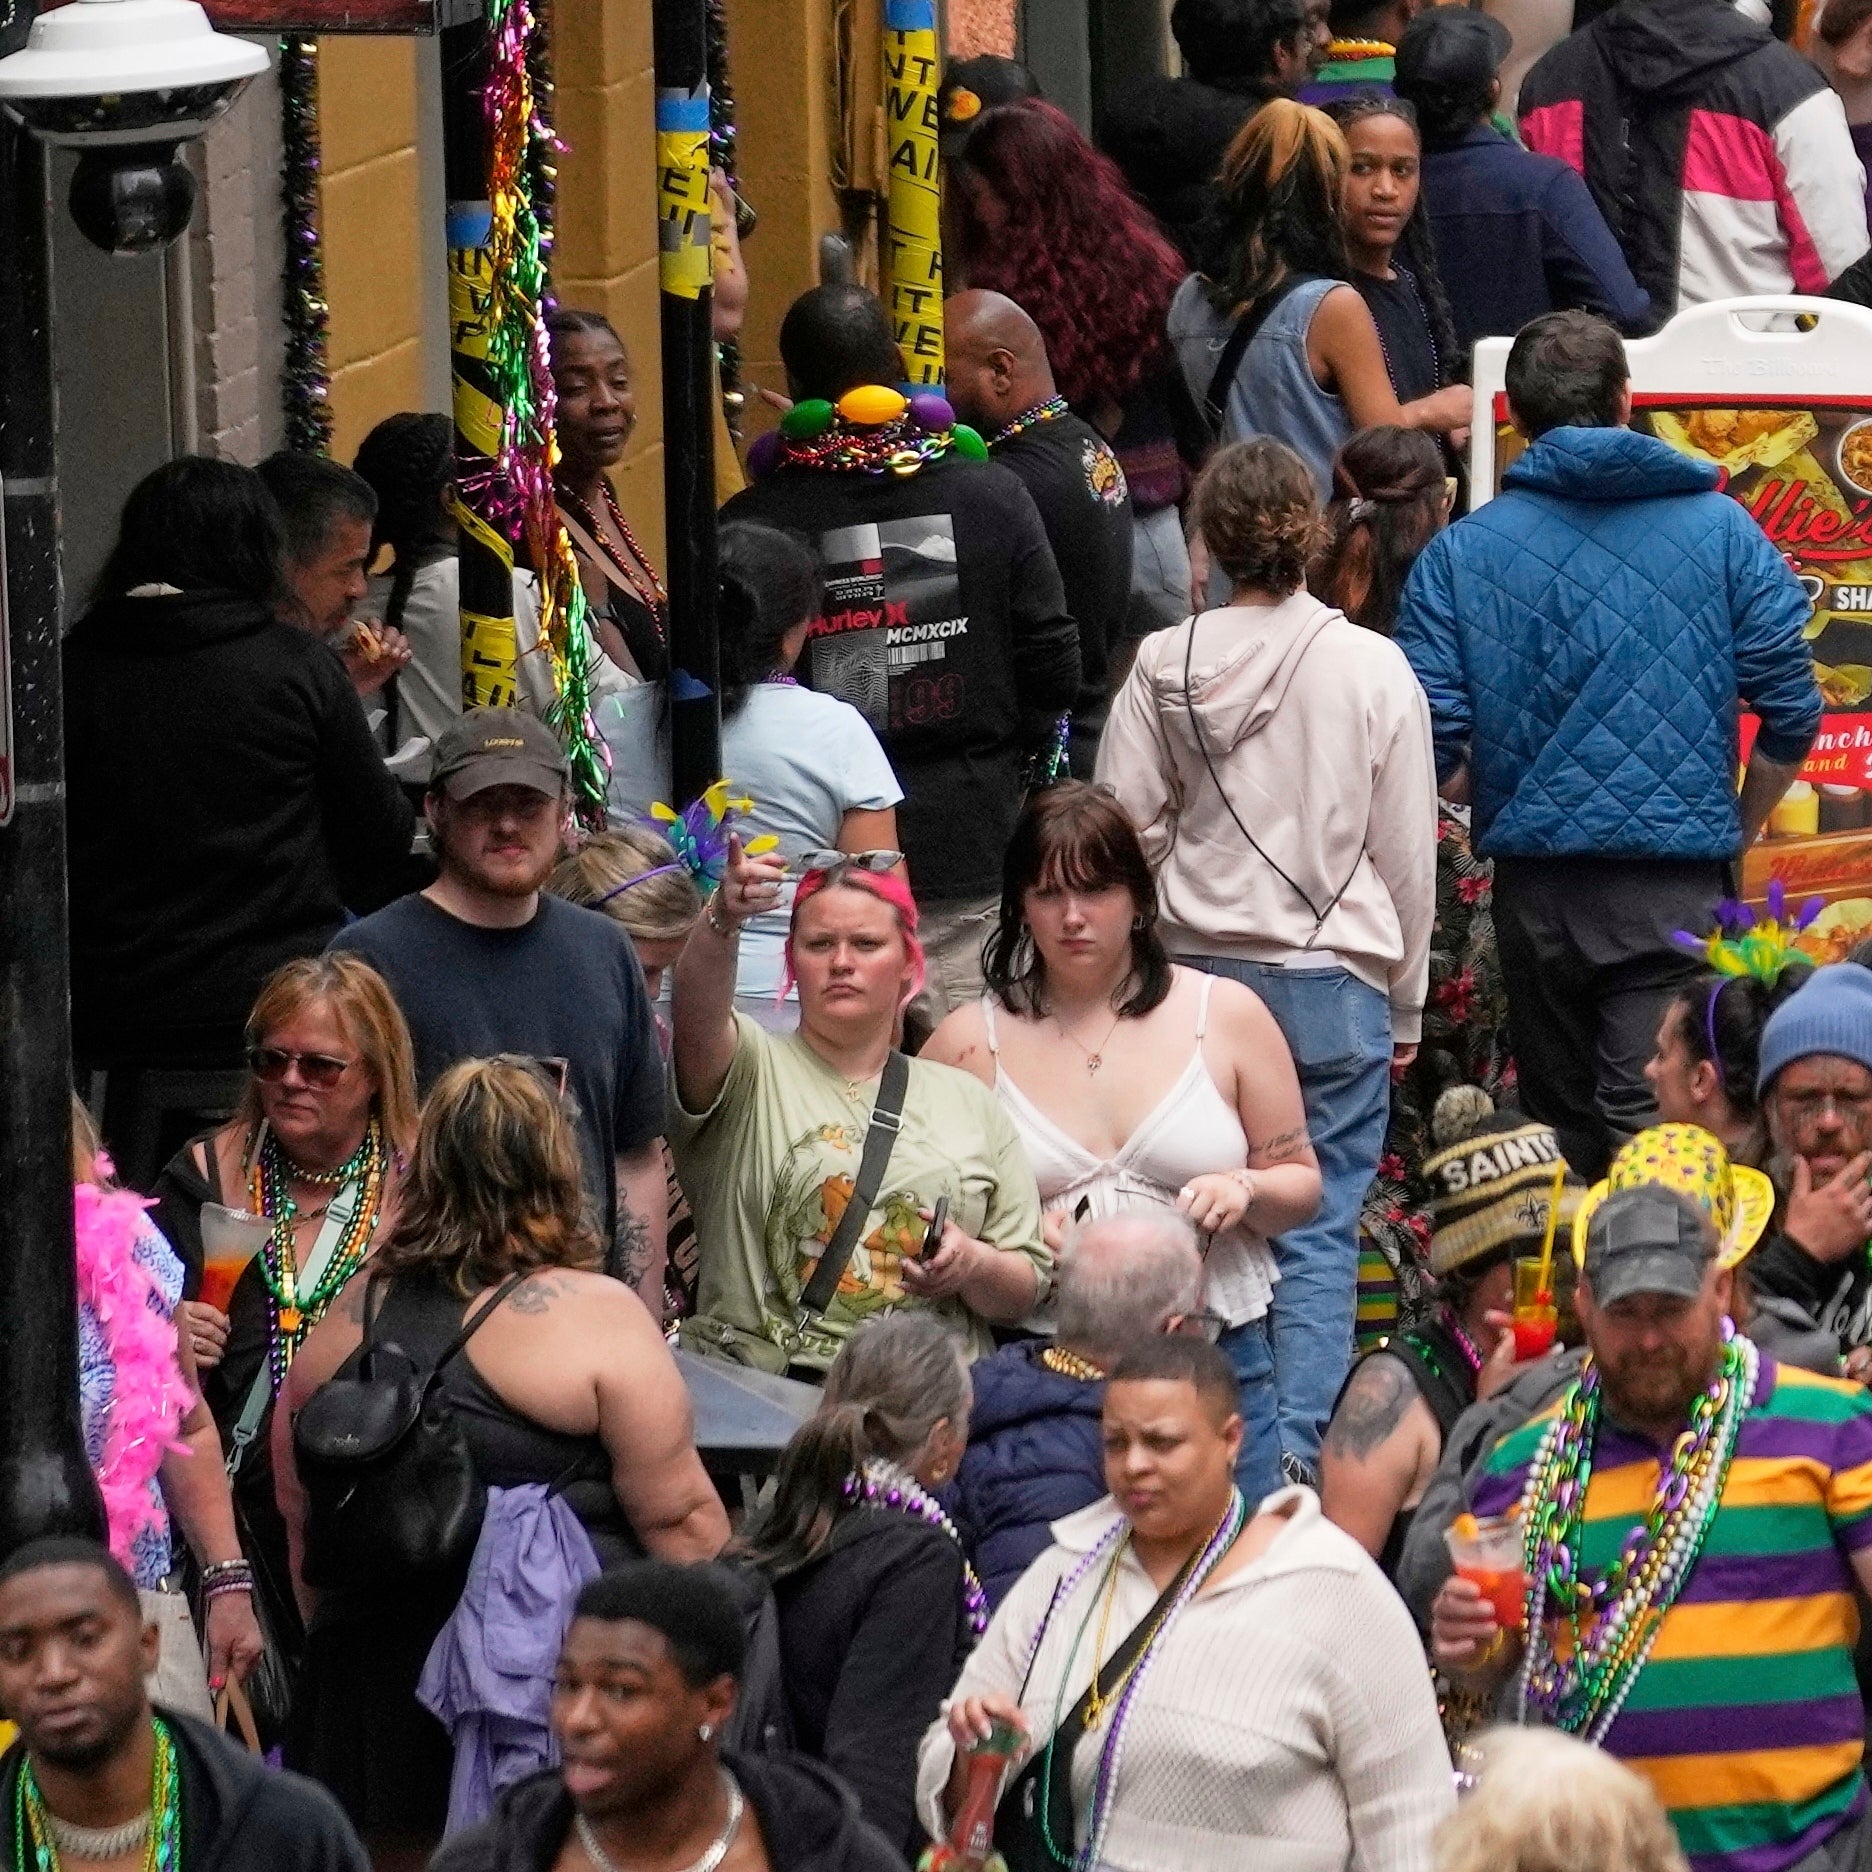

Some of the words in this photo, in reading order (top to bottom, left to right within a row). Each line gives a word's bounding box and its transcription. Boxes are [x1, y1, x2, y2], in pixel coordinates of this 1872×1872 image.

[886, 617, 970, 646] MCMXCIX
[1803, 753, 1849, 776] and
[1442, 1132, 1562, 1194] SAINTS
